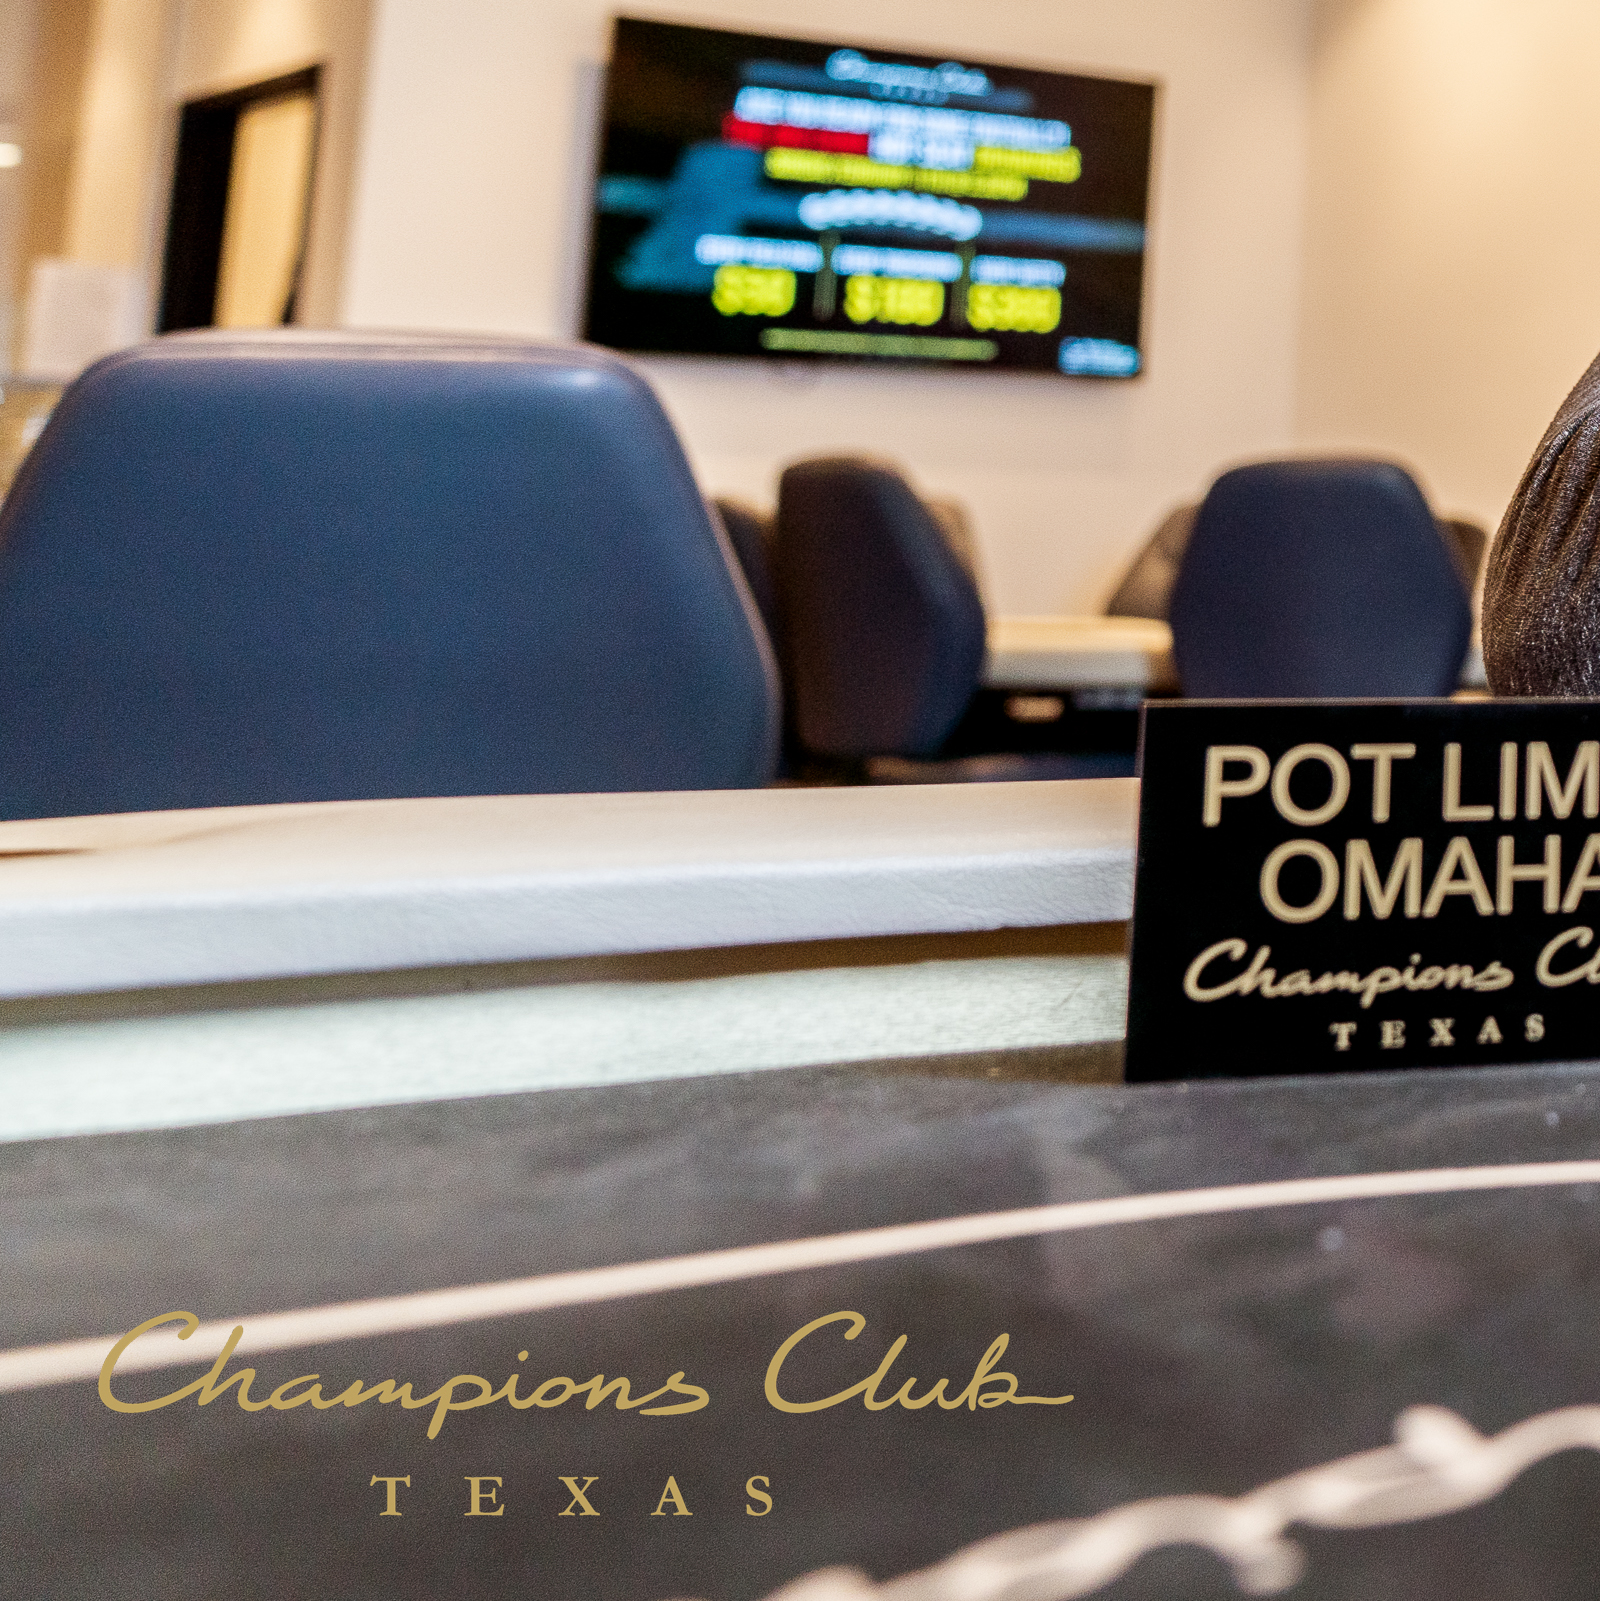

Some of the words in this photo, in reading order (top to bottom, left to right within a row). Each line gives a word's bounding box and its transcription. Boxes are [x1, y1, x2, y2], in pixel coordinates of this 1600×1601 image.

[1202, 743, 1416, 827] POT
[1184, 937, 1514, 1008] Champions
[1330, 1013, 1545, 1051] TEXAS
